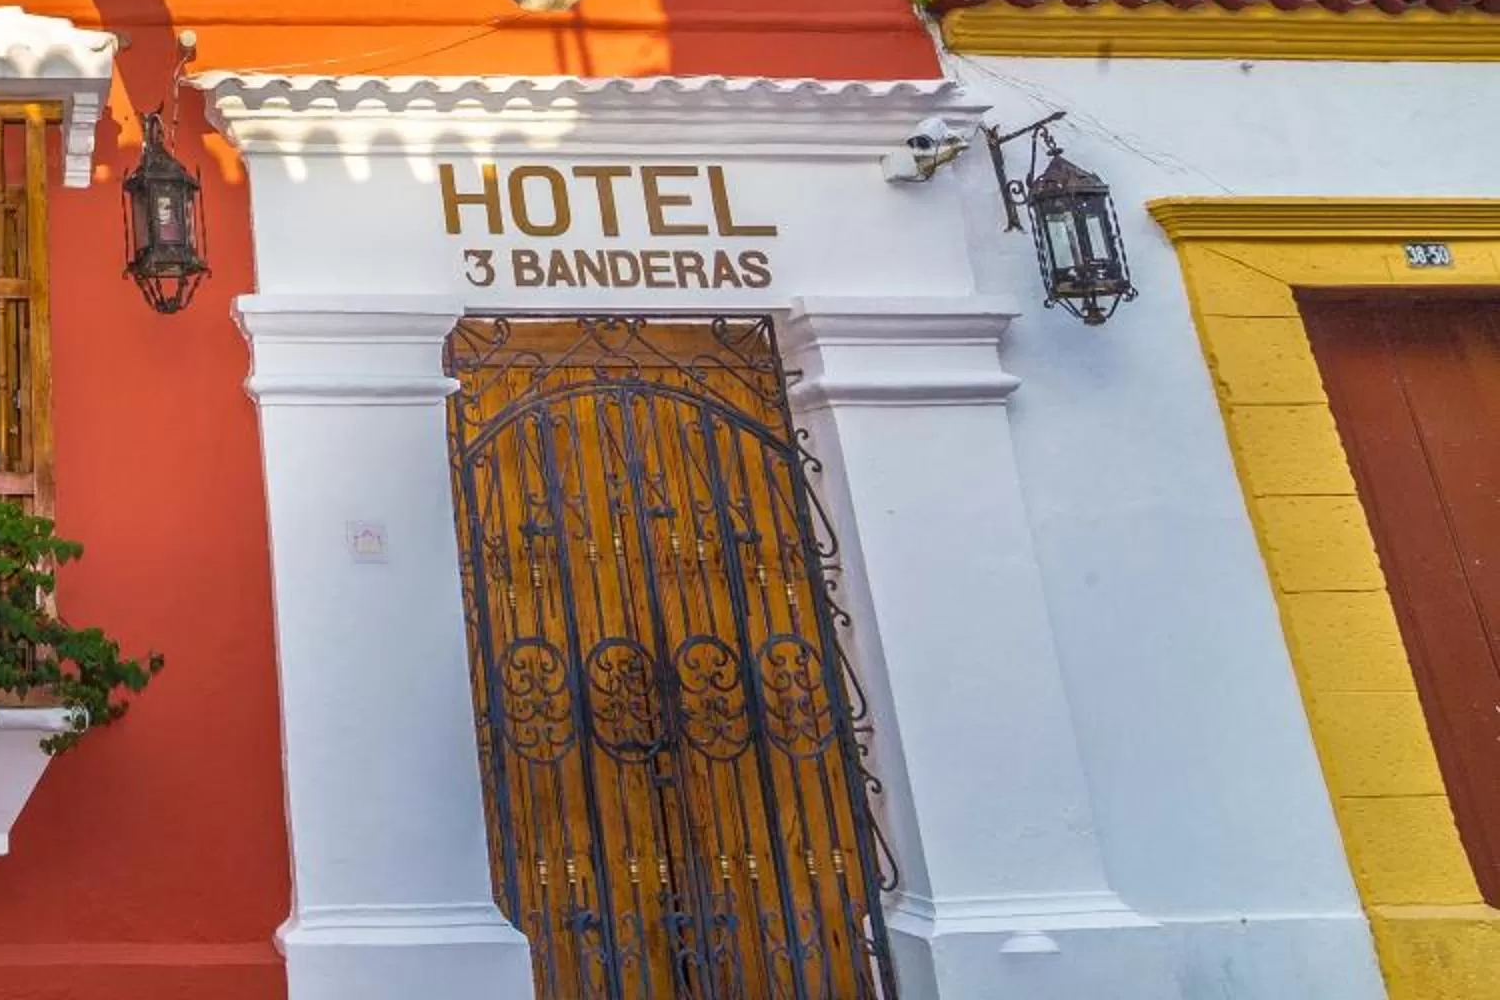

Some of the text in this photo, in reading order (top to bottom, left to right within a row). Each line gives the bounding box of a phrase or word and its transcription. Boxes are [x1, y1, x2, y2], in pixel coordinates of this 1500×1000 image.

[438, 163, 778, 237] HOTEL
[463, 249, 772, 288] 3 BANDERAS
